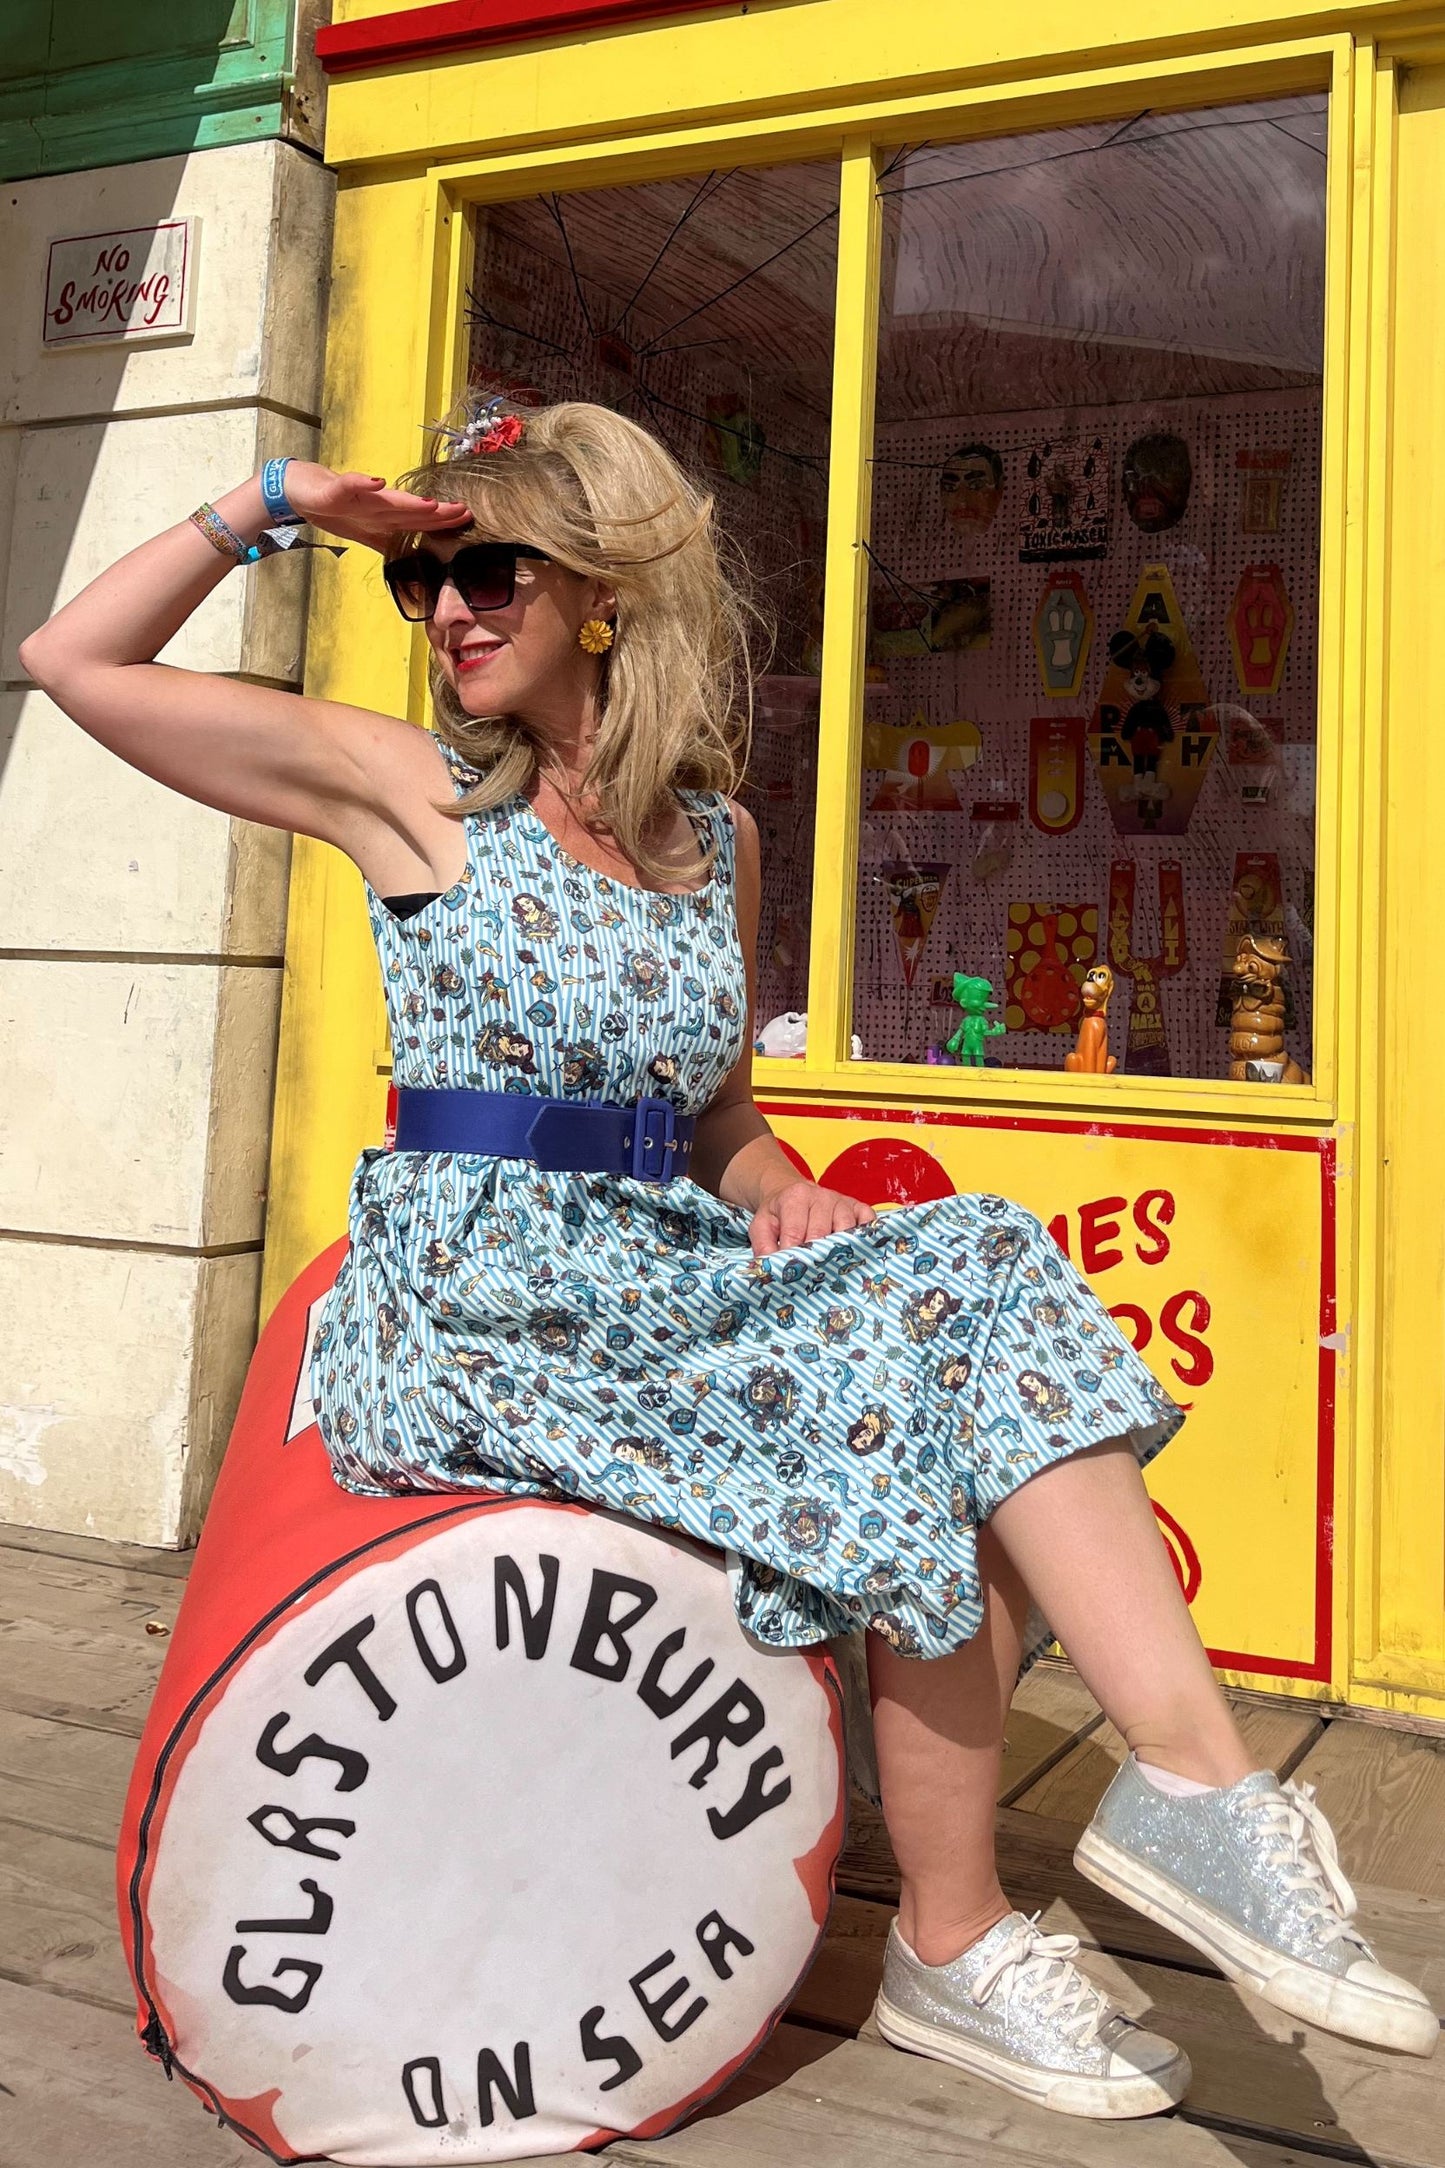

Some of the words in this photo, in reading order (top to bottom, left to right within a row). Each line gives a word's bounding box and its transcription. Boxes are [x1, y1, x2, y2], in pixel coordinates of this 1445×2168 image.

[93, 244, 130, 276] NO
[48, 273, 170, 324] SMOKING
[1140, 996, 1151, 1008] A
[222, 1553, 792, 2014] GLASTONBURY
[401, 2040, 537, 2128] ON
[579, 1909, 755, 2092] SEA
